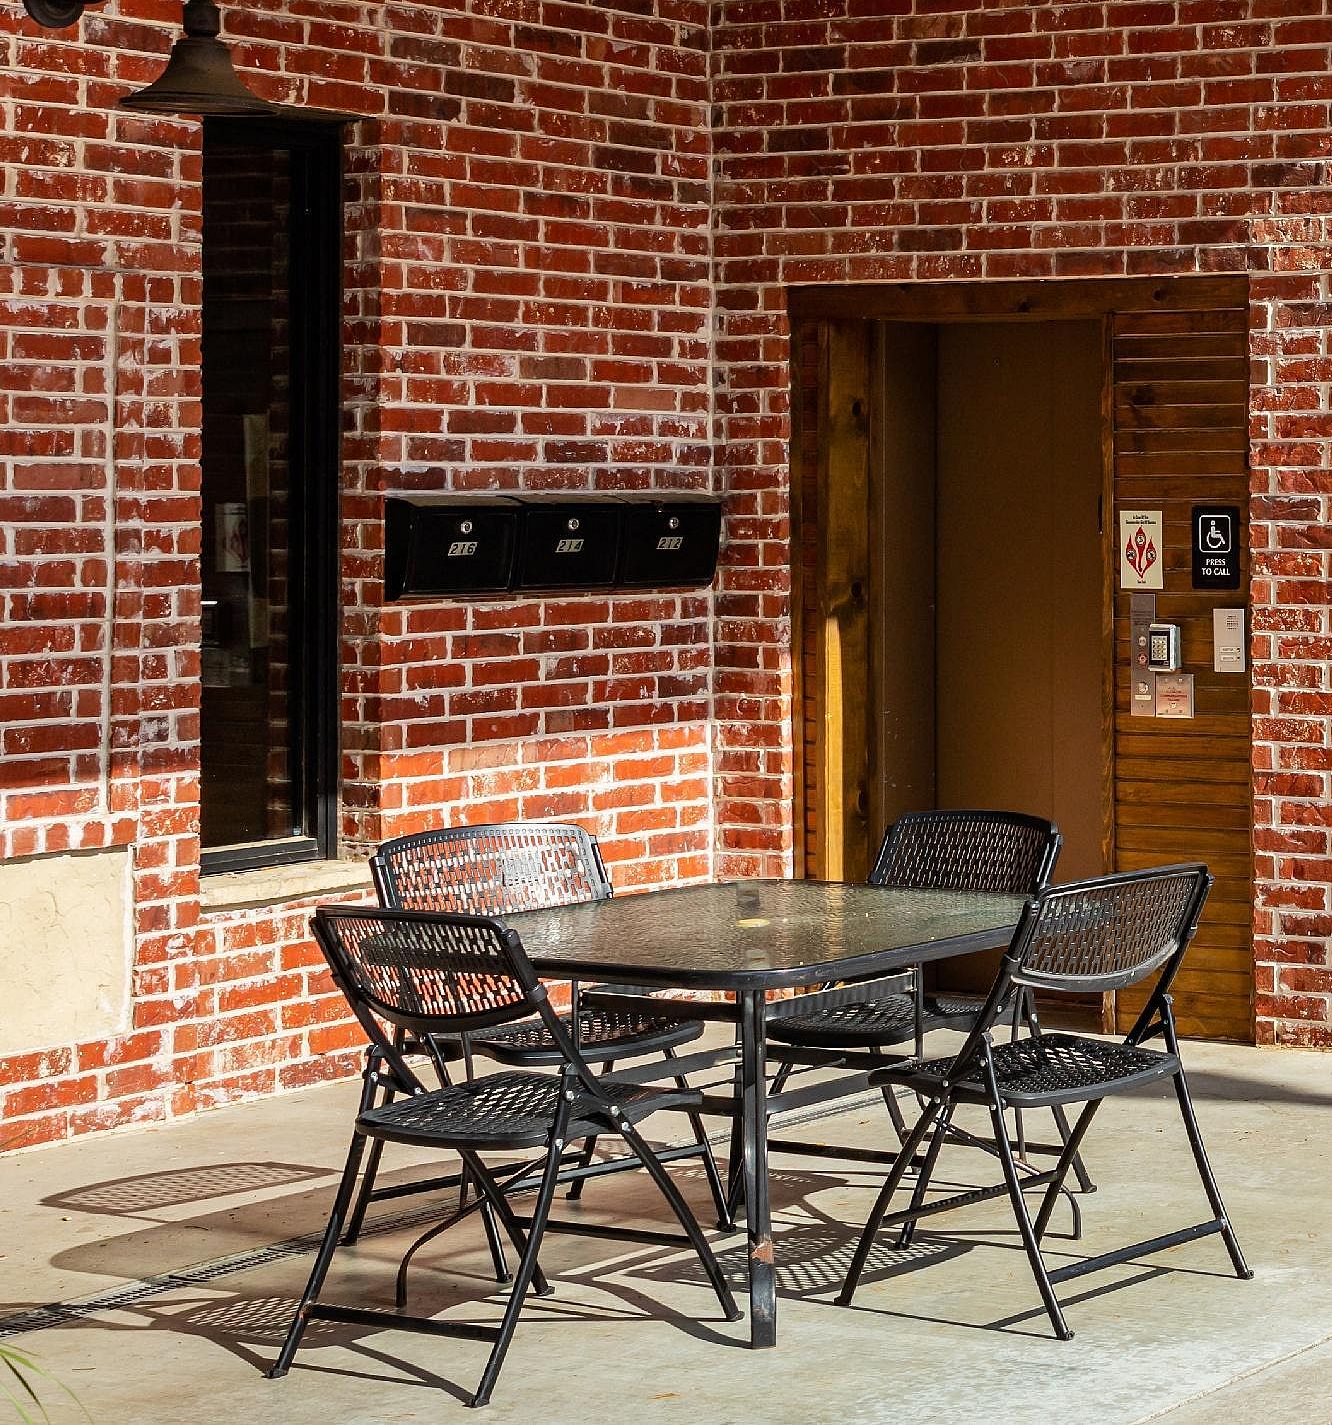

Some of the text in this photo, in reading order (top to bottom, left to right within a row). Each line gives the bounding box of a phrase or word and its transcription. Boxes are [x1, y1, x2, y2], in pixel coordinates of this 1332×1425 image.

[450, 543, 476, 555] 216
[557, 539, 583, 552] 214
[658, 537, 683, 549] 212
[1205, 558, 1226, 566] PRESS
[1201, 567, 1231, 576] TO CALL
